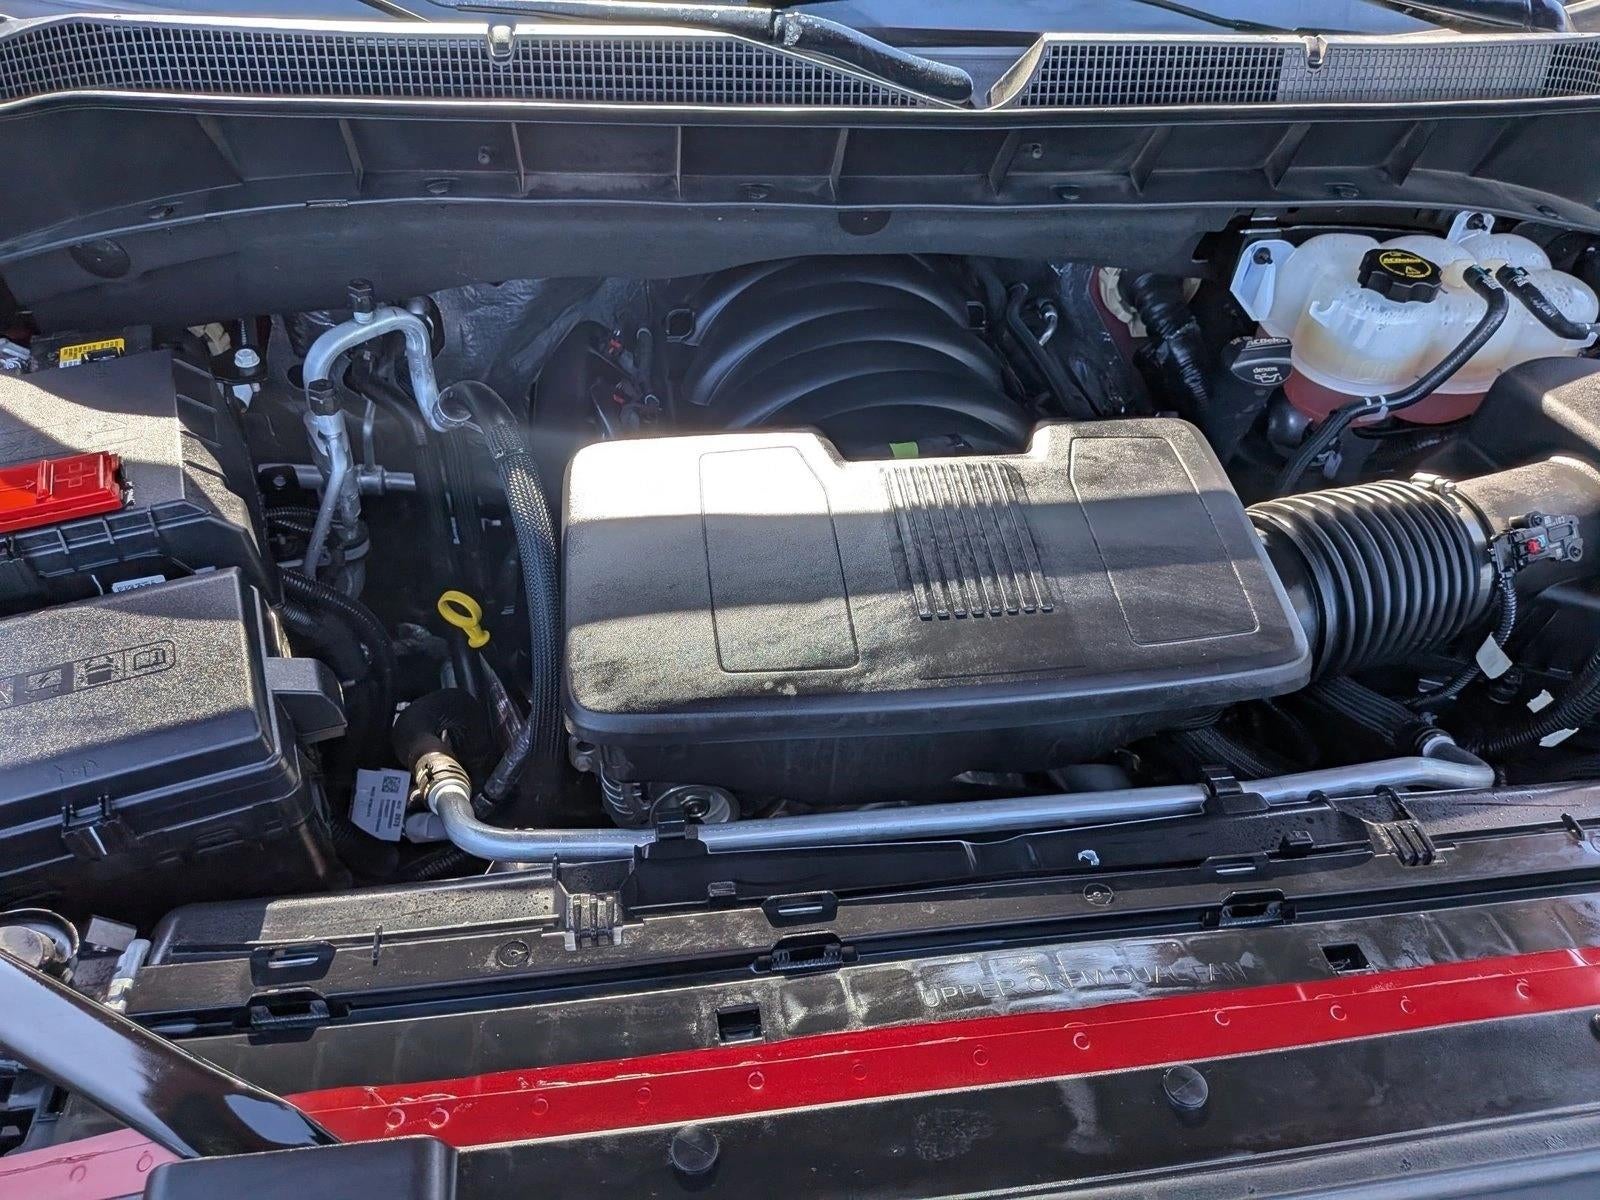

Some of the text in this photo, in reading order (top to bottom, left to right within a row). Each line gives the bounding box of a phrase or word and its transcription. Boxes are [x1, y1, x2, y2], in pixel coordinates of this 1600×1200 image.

[1246, 337, 1288, 348] ACDelco
[921, 978, 1020, 1007] UPPER
[1112, 965, 1190, 984] DUAL
[1192, 961, 1248, 983] FAN
